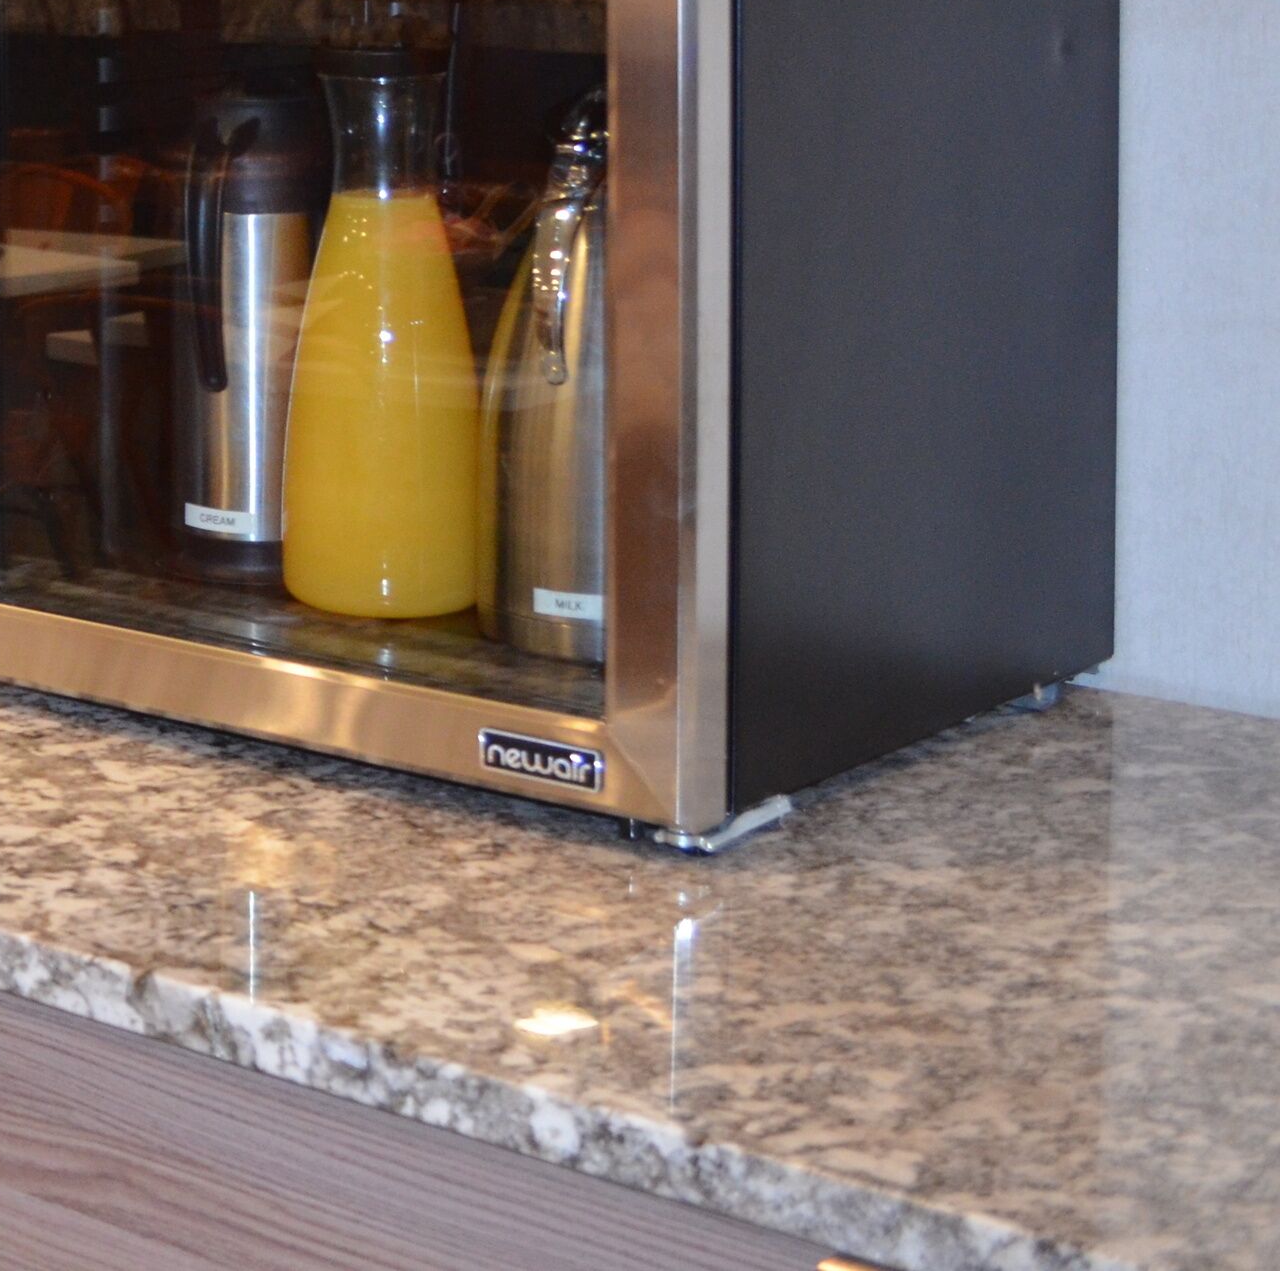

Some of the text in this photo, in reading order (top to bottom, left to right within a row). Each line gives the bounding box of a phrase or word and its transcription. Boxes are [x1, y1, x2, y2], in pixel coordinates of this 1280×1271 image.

[199, 512, 236, 526] CREAM
[555, 597, 582, 611] MILK
[486, 743, 592, 783] newair
